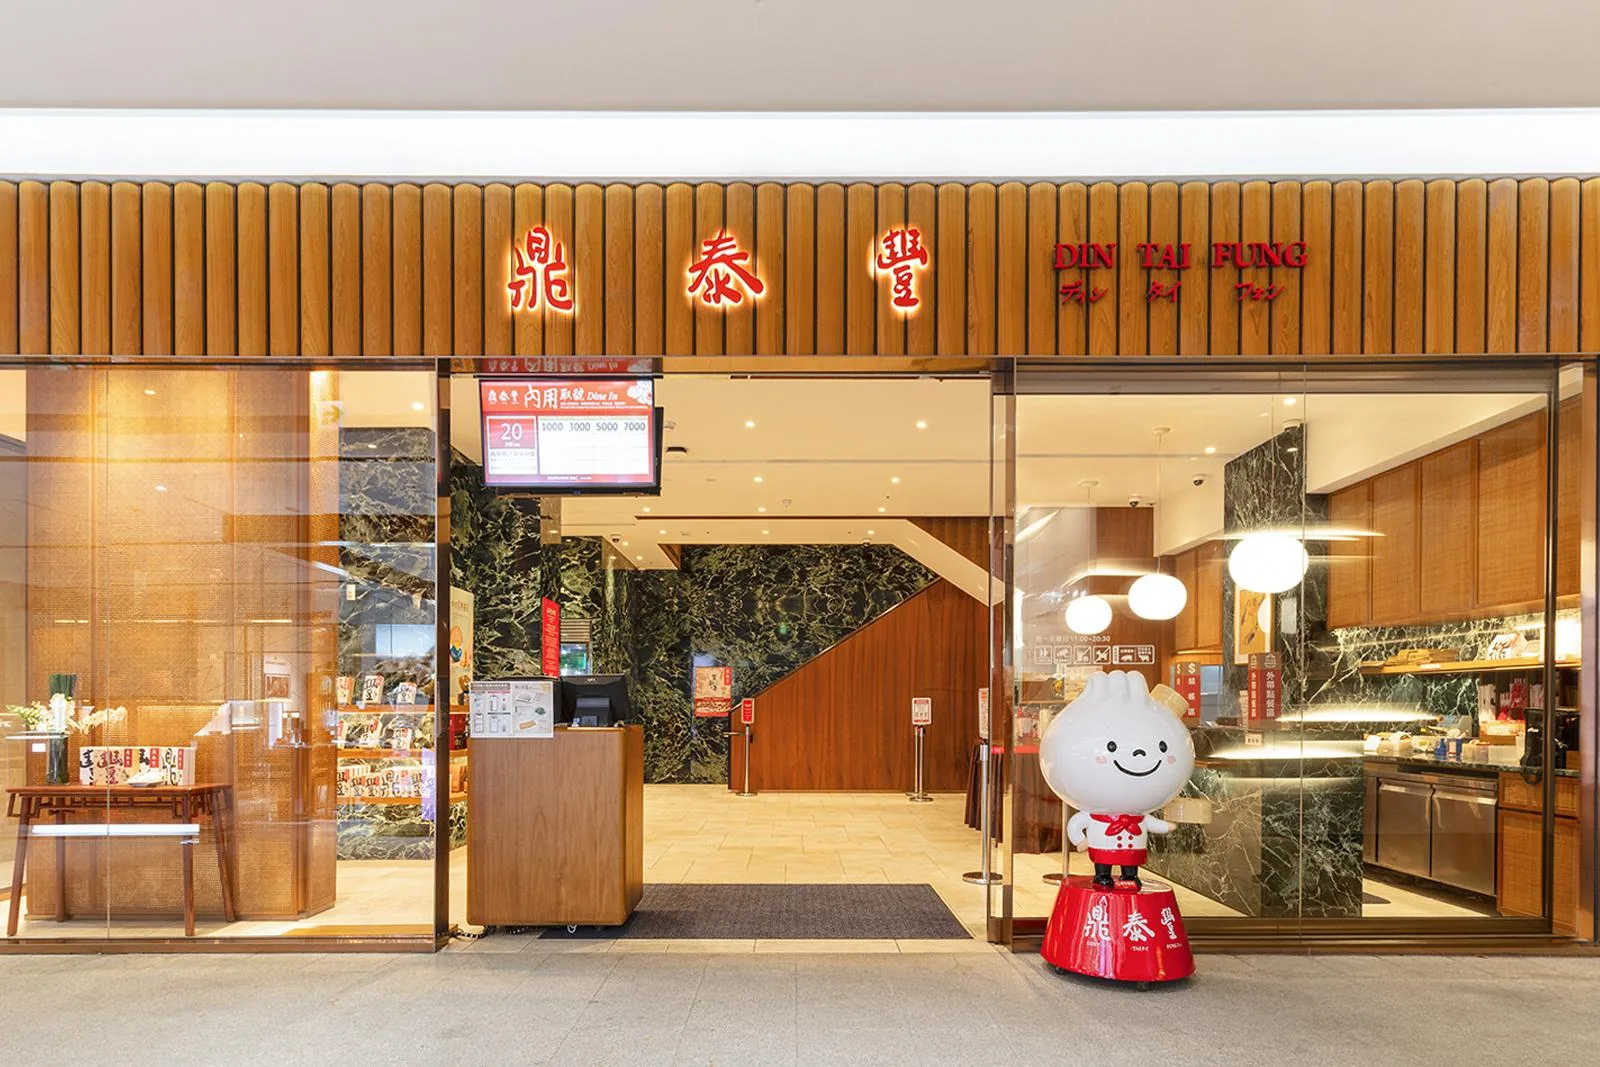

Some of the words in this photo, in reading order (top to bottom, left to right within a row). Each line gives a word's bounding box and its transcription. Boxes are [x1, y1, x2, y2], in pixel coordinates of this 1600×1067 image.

[1054, 242, 1116, 270] DIN
[1136, 242, 1191, 270] TAI
[1211, 241, 1307, 269] FUNG
[1145, 280, 1182, 304] タイ
[586, 391, 607, 401] Dine
[608, 391, 619, 401] In
[500, 423, 524, 441] 20
[541, 422, 564, 432] 1000
[568, 422, 591, 432] 3000
[596, 422, 619, 432] 5000
[623, 422, 646, 432] 7000
